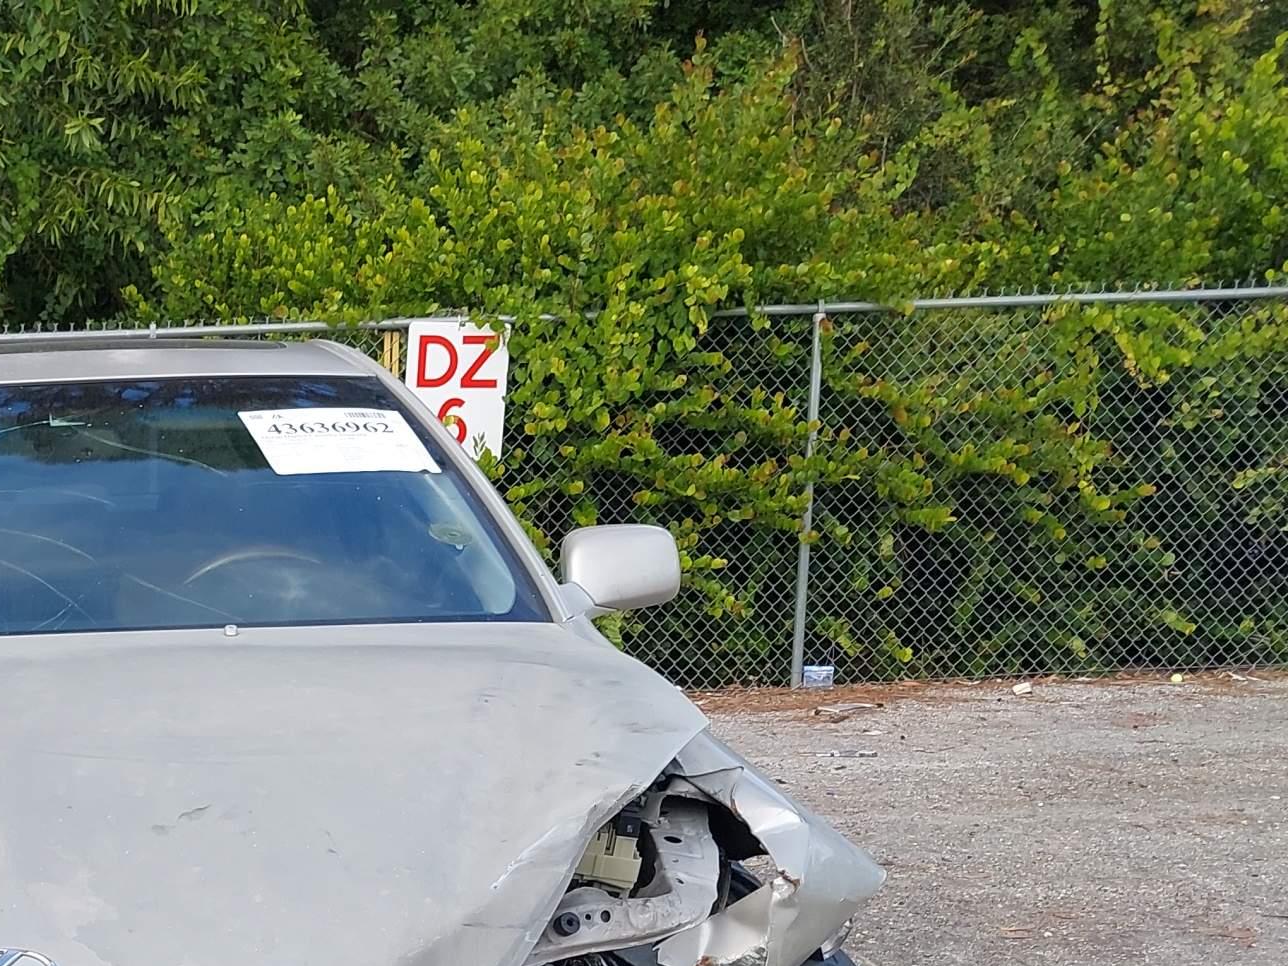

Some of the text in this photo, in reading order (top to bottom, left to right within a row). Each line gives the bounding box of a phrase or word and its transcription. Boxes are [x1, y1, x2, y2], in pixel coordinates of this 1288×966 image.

[416, 335, 500, 388] DZ
[267, 422, 394, 434] 43636962
[437, 398, 467, 444] 6
